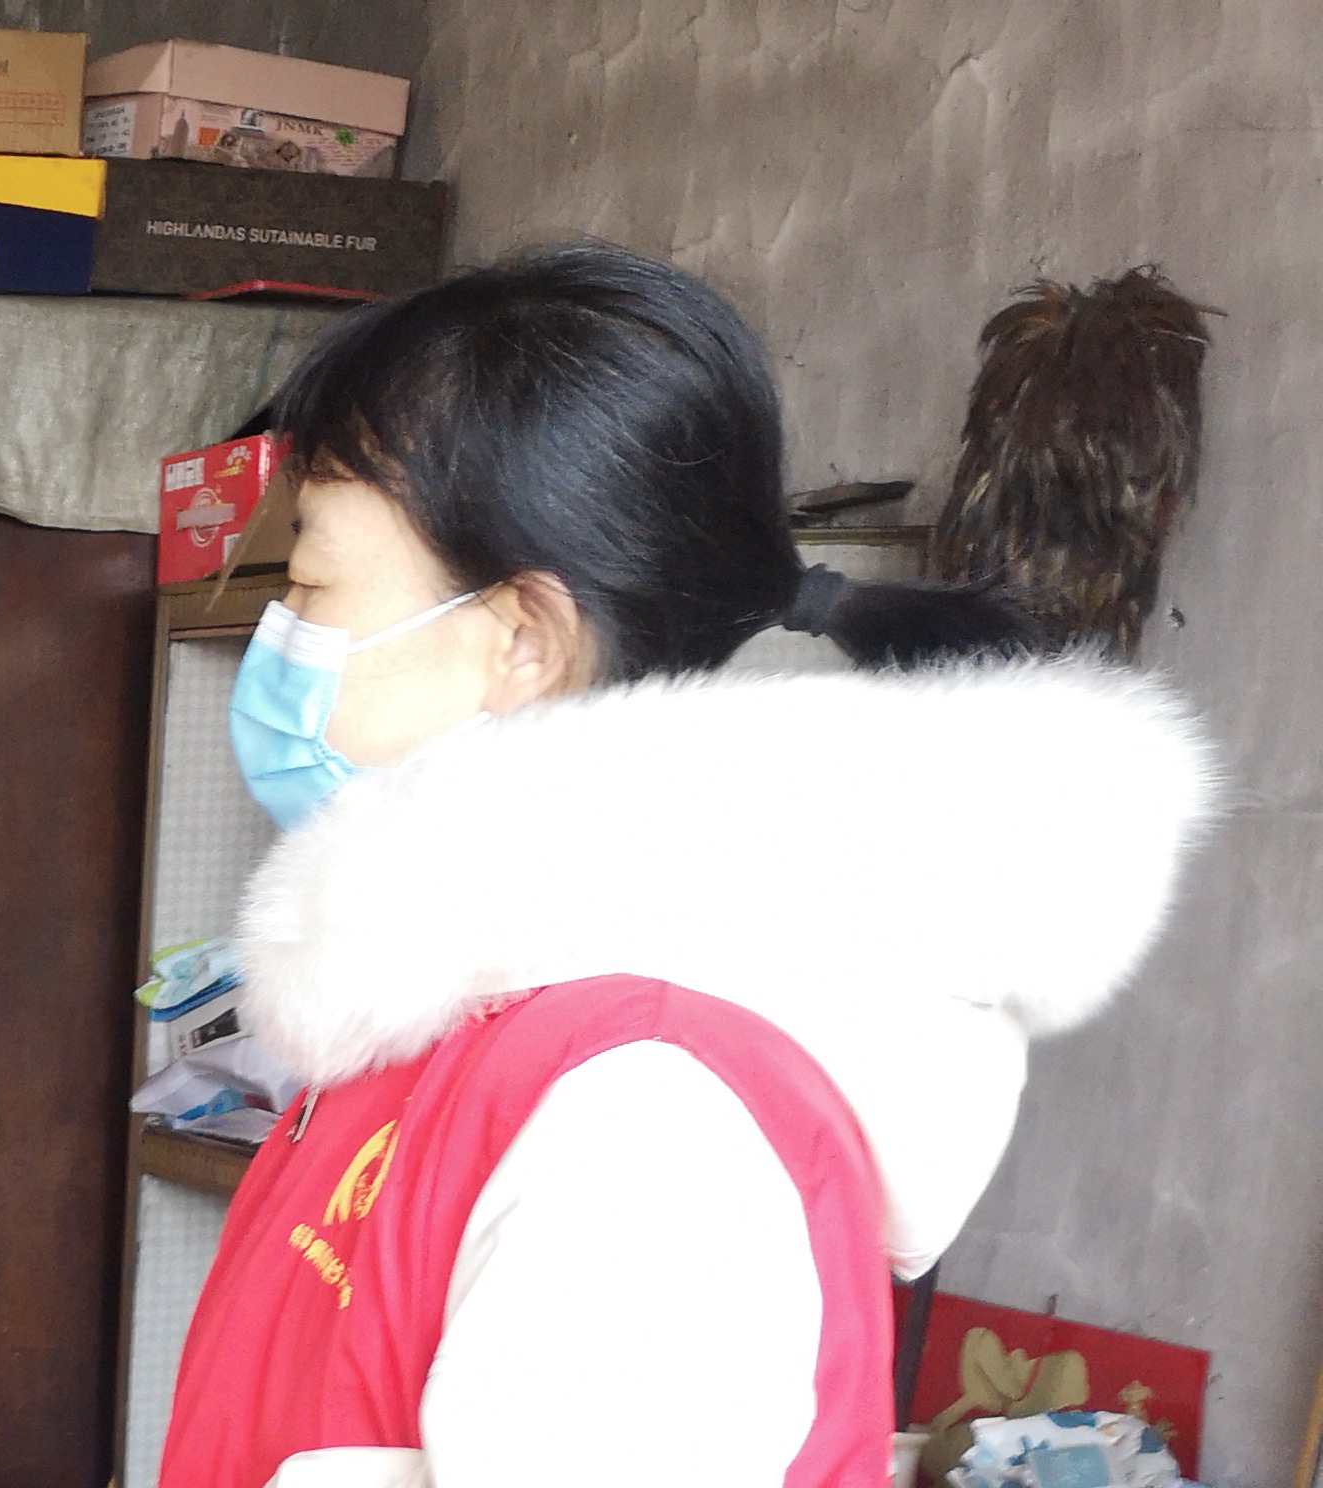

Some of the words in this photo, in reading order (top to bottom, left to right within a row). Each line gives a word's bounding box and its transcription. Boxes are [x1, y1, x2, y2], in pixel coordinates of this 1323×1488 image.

[146, 220, 245, 242] HIGHLANDAS
[249, 228, 343, 249] SUTAINABLE
[345, 235, 378, 251] FUR
